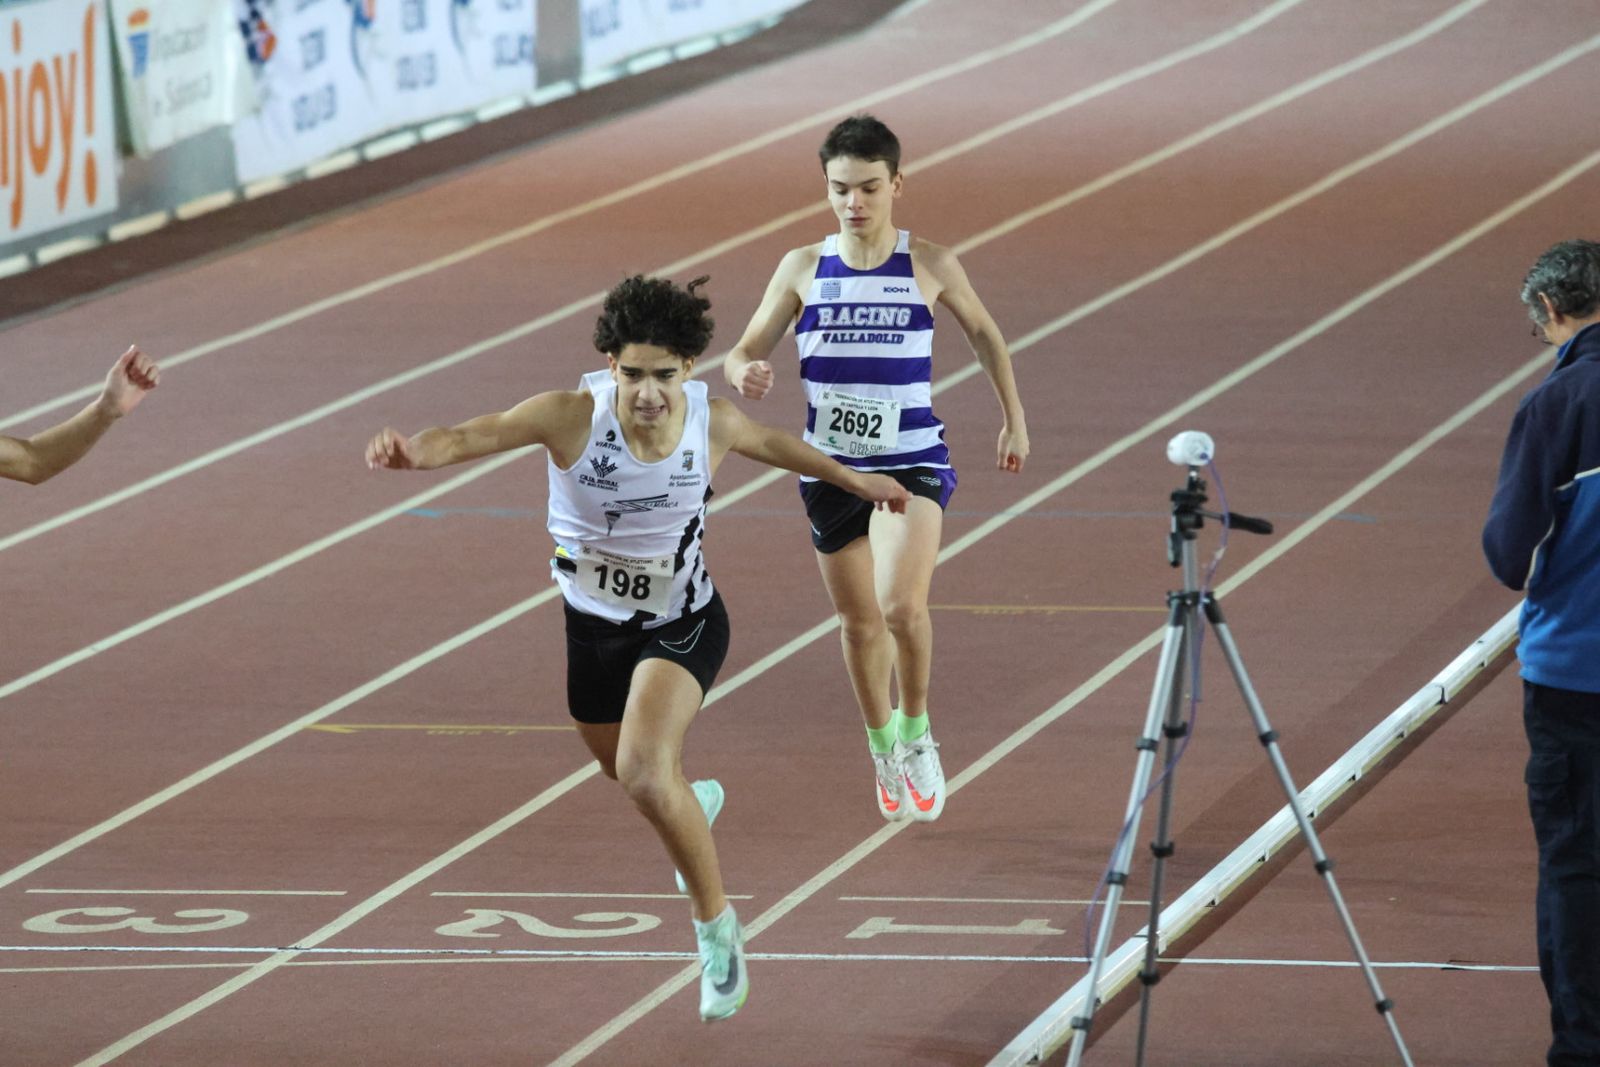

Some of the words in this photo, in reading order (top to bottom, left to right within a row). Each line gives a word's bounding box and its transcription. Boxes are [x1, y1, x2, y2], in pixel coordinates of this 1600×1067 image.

[817, 306, 913, 328] RACING
[822, 333, 905, 344] VALLADOLID
[829, 407, 883, 439] 2692
[594, 564, 651, 600] 198
[22, 907, 250, 934] 3
[434, 909, 662, 938] 2
[845, 916, 1067, 939] 1
